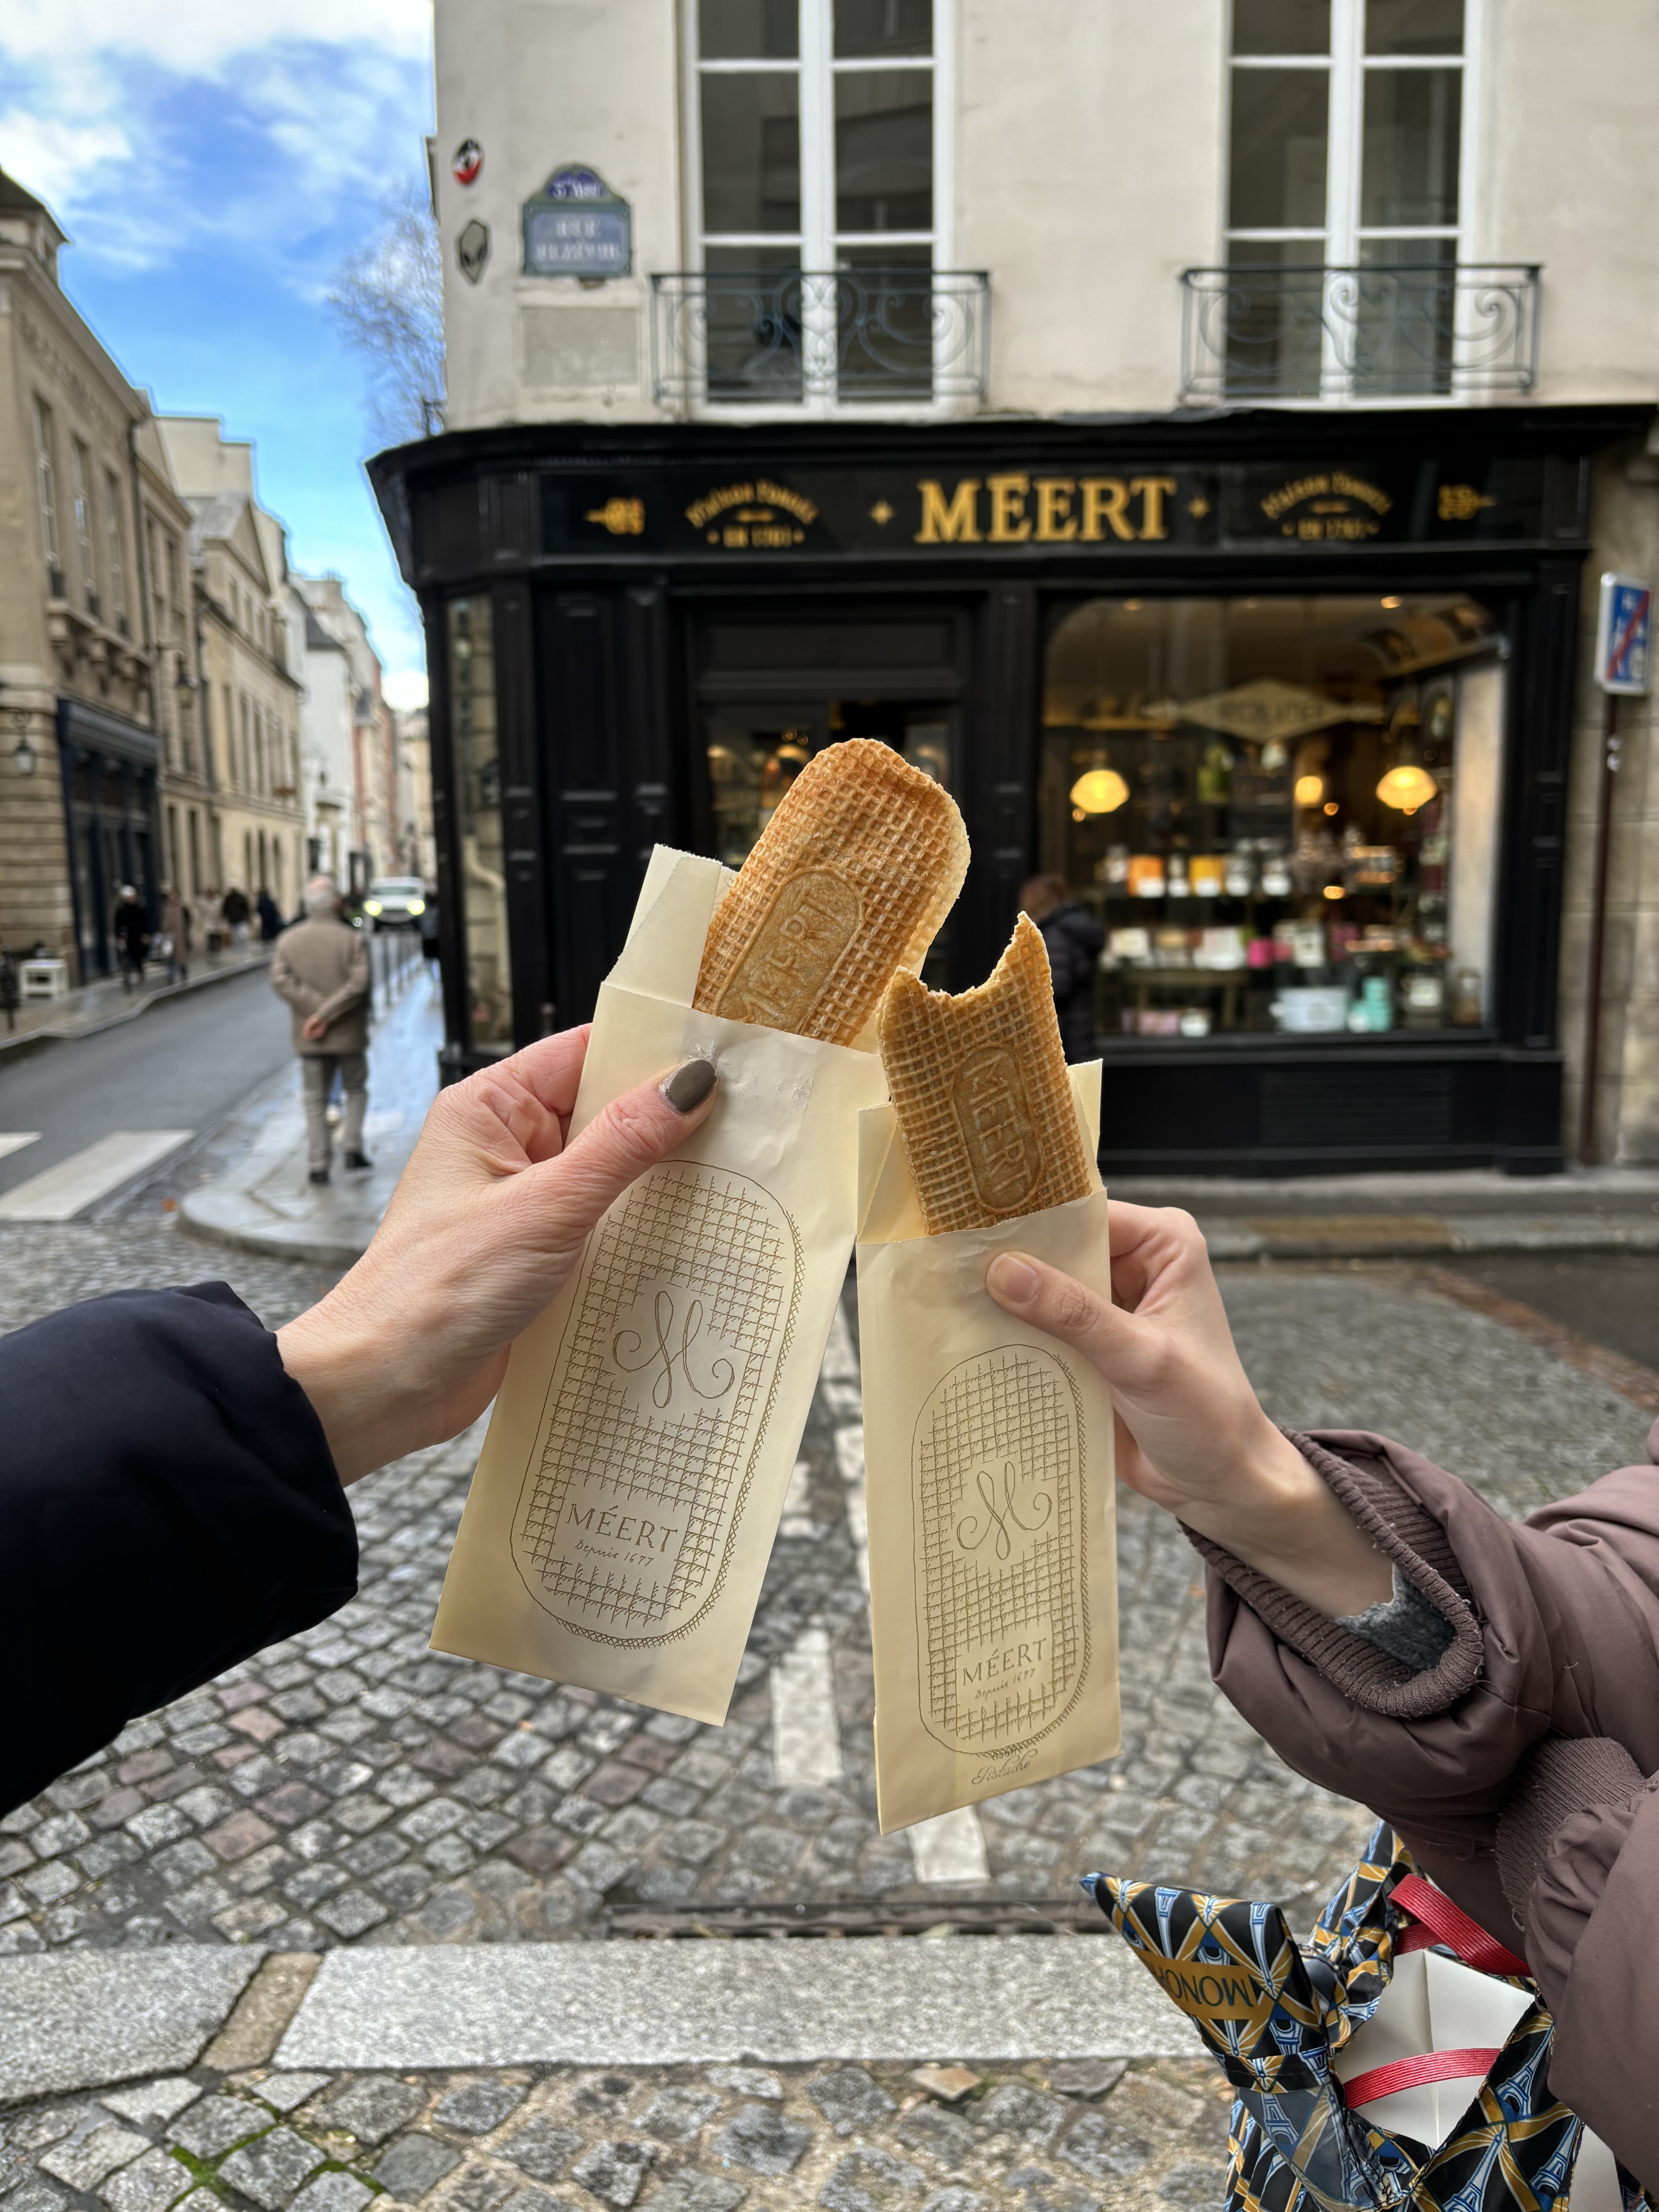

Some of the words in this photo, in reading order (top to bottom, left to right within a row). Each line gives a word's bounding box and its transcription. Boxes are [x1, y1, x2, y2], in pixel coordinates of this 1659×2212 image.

[566, 1503, 678, 1552] MÉERT
[574, 1539, 618, 1558] Depuis
[624, 1552, 654, 1567] 1677
[963, 1637, 1046, 1685] MÉERT
[1013, 1668, 1036, 1683] 1677
